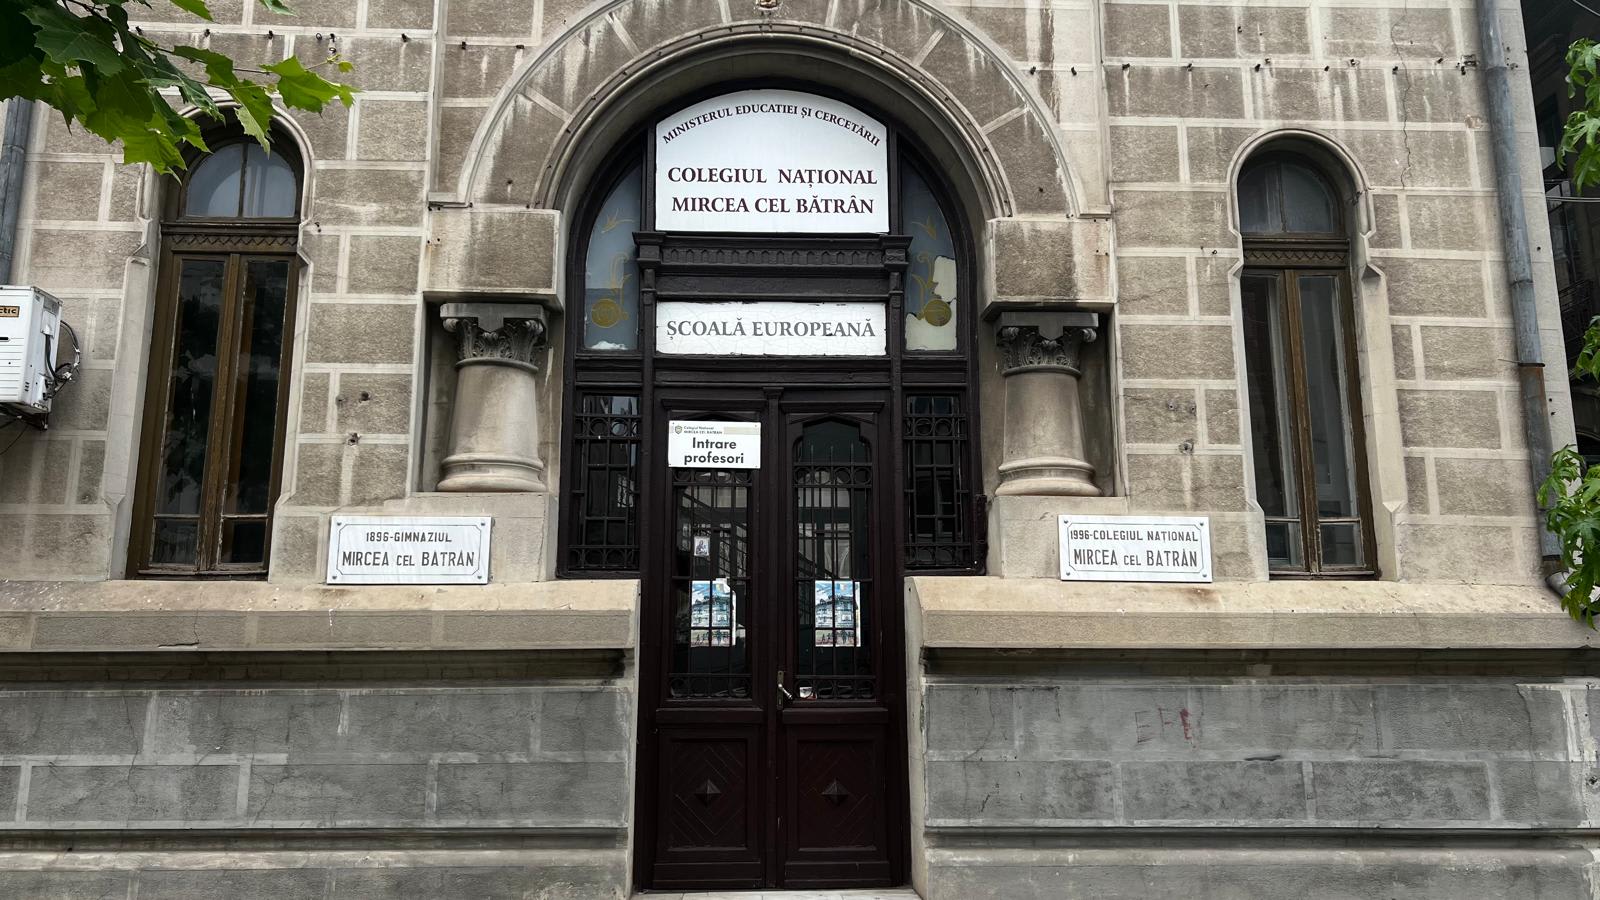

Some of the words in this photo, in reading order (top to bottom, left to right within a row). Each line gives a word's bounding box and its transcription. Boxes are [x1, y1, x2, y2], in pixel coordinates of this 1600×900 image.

[662, 107, 733, 144] MINISTERUL
[814, 109, 881, 147] CERCETĂRII
[667, 167, 767, 183] COLEGIUL
[777, 168, 878, 188] NAȚIONAL
[672, 196, 750, 212] MIRCEA
[754, 197, 791, 213] CEL
[796, 195, 874, 214] BĂTRÂN
[666, 317, 747, 340] ȘCOALĂ
[752, 318, 876, 337] EUROPEANĂ
[692, 437, 737, 449] Intrare
[684, 451, 744, 465] profesori
[366, 531, 452, 543] 1896-GIMNAZIUL
[1070, 529, 1143, 541] 1996-COLEGIUL
[342, 551, 389, 566] MIRCEA
[1073, 548, 1118, 566] MIRCEA
